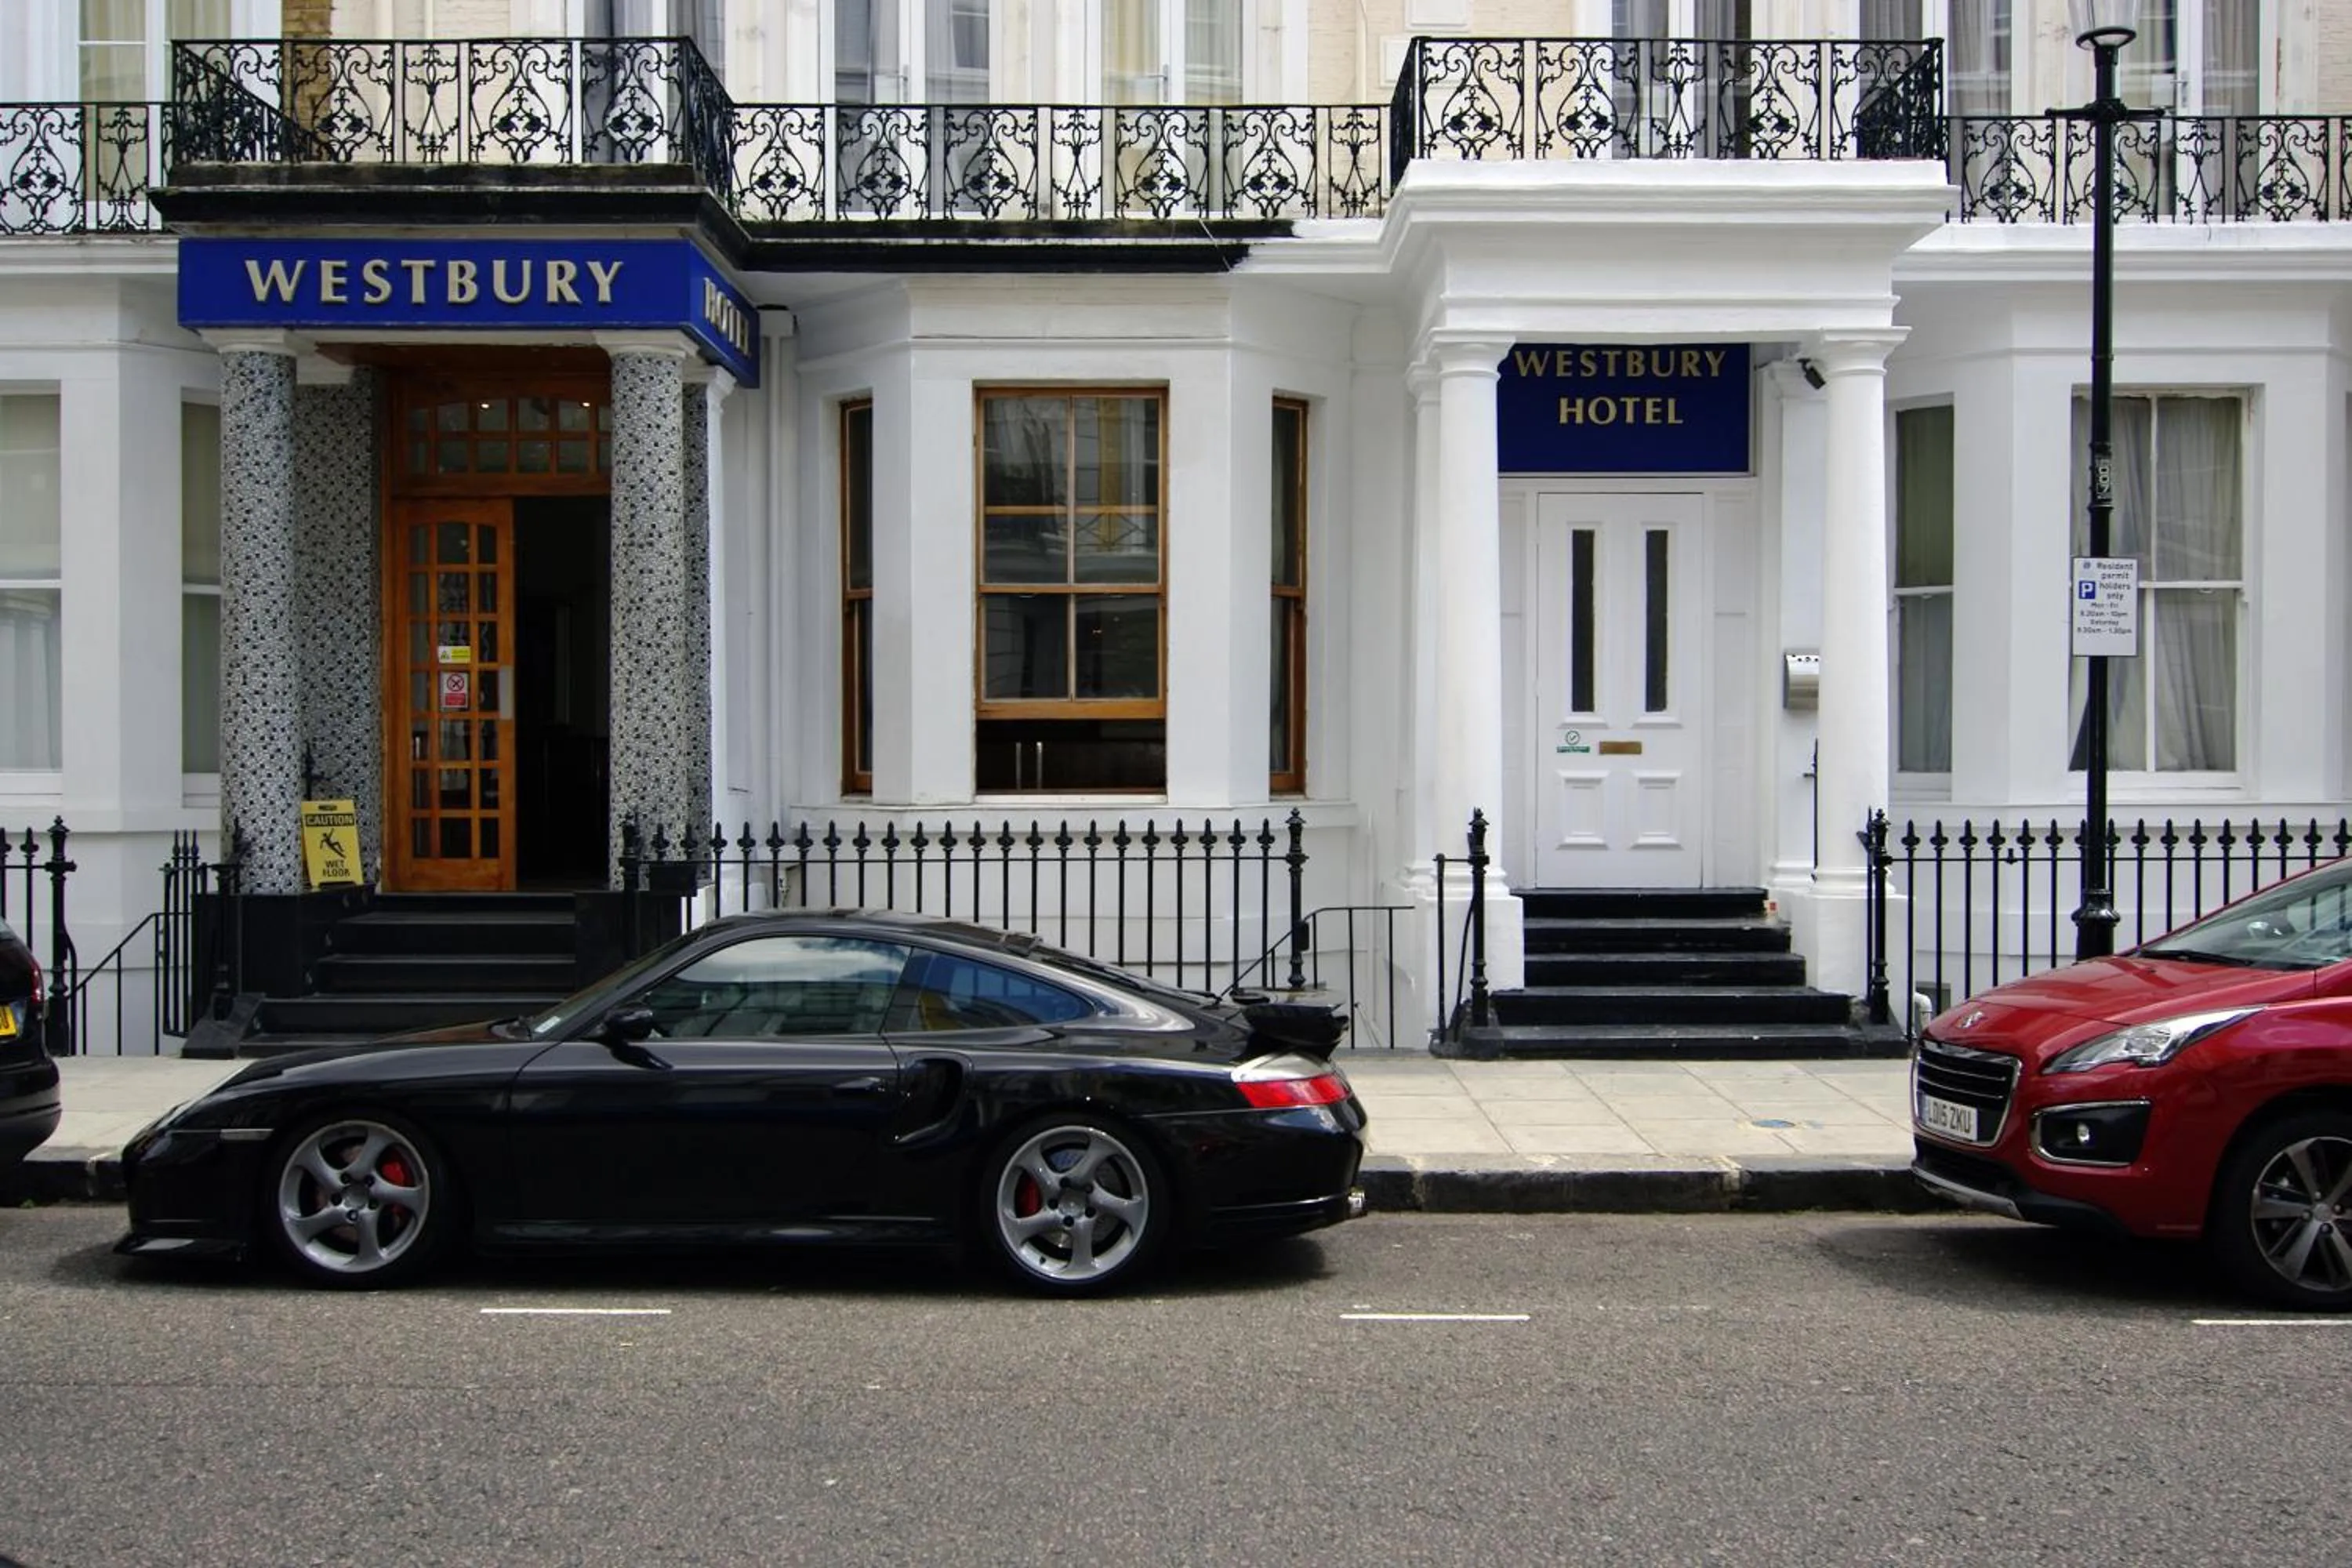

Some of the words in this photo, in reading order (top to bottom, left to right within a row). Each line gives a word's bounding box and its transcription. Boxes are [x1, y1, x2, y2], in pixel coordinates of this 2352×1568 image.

[245, 260, 622, 303] WESTBURY
[1515, 350, 1726, 378] WESTBURY
[1559, 396, 1684, 424] HOTEL
[307, 815, 354, 826] CAUTION
[322, 868, 350, 877] FLOOR
[325, 859, 345, 868] WET
